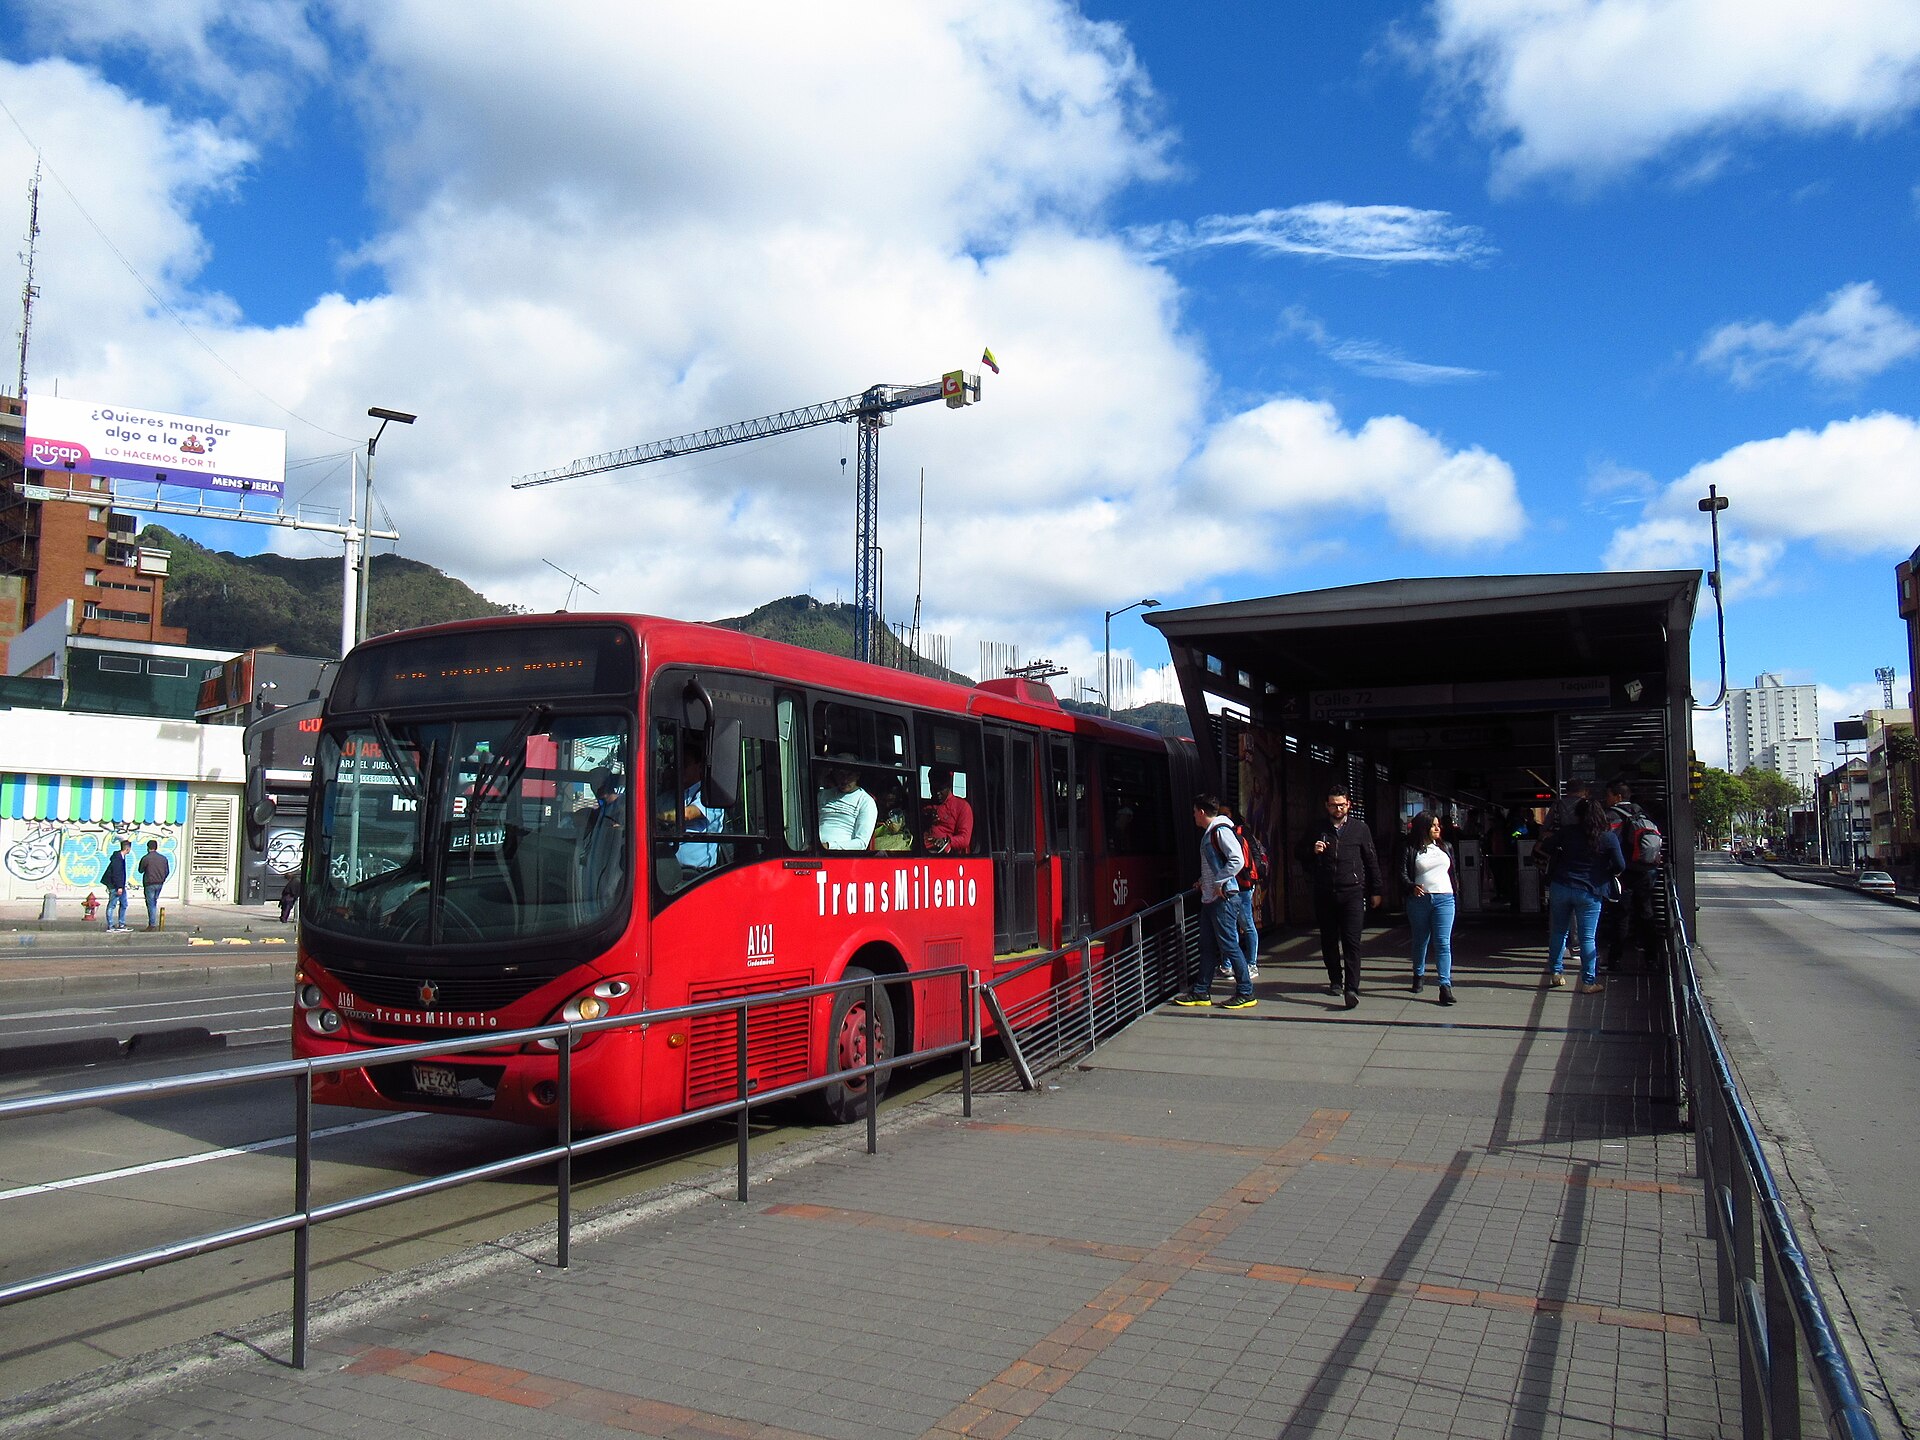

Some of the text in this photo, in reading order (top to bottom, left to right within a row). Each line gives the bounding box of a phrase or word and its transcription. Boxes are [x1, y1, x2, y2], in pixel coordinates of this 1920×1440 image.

[91, 409, 231, 437] ¿Quieres mandar
[105, 426, 217, 452] algo a la ?
[32, 441, 82, 463] picap
[105, 447, 216, 468] LO HACEMOS POR TI
[1559, 679, 1605, 692] Taquilla
[1314, 691, 1373, 706] Calle 72
[340, 760, 355, 768] ARA
[815, 864, 978, 916] TransMilenio
[747, 923, 773, 955] A161
[338, 991, 355, 1007] A161
[376, 1008, 498, 1027] TransMilenio
